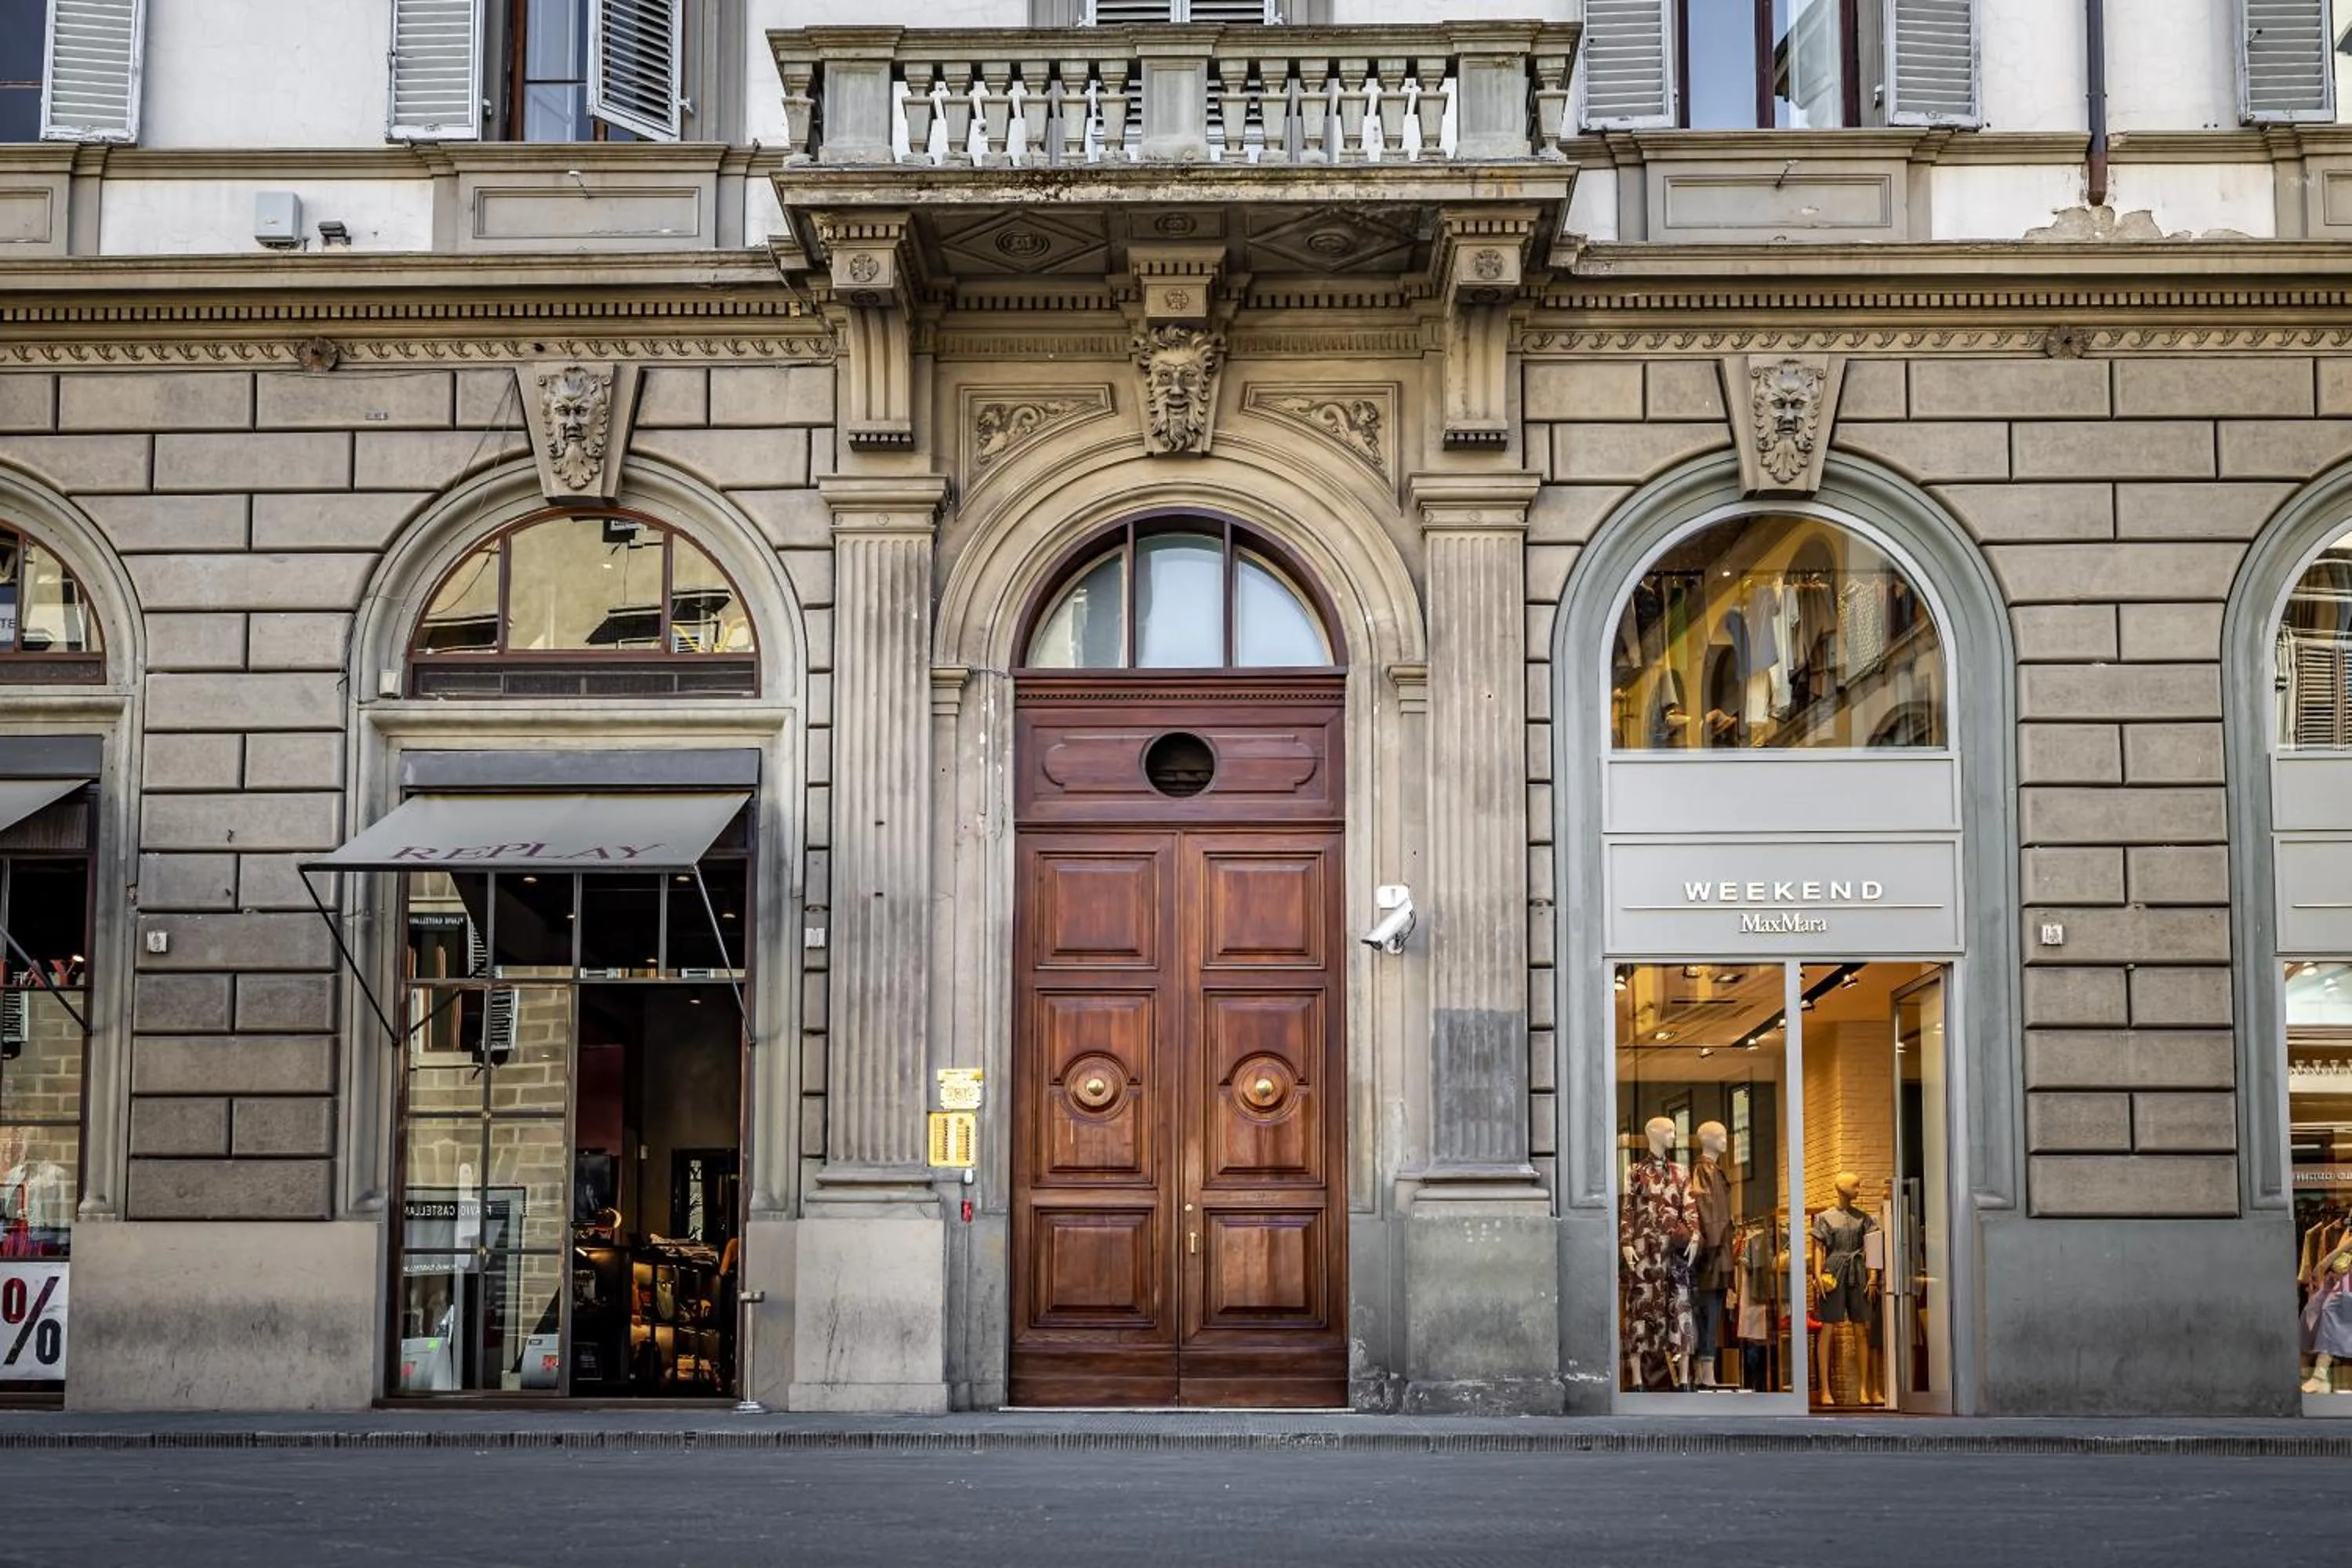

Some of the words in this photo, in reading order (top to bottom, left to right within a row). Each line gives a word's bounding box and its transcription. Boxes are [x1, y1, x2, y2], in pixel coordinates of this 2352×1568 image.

[390, 841, 666, 860] REPLAY
[1684, 880, 1883, 901] WEEKEND
[1740, 912, 1828, 933] MaxMara
